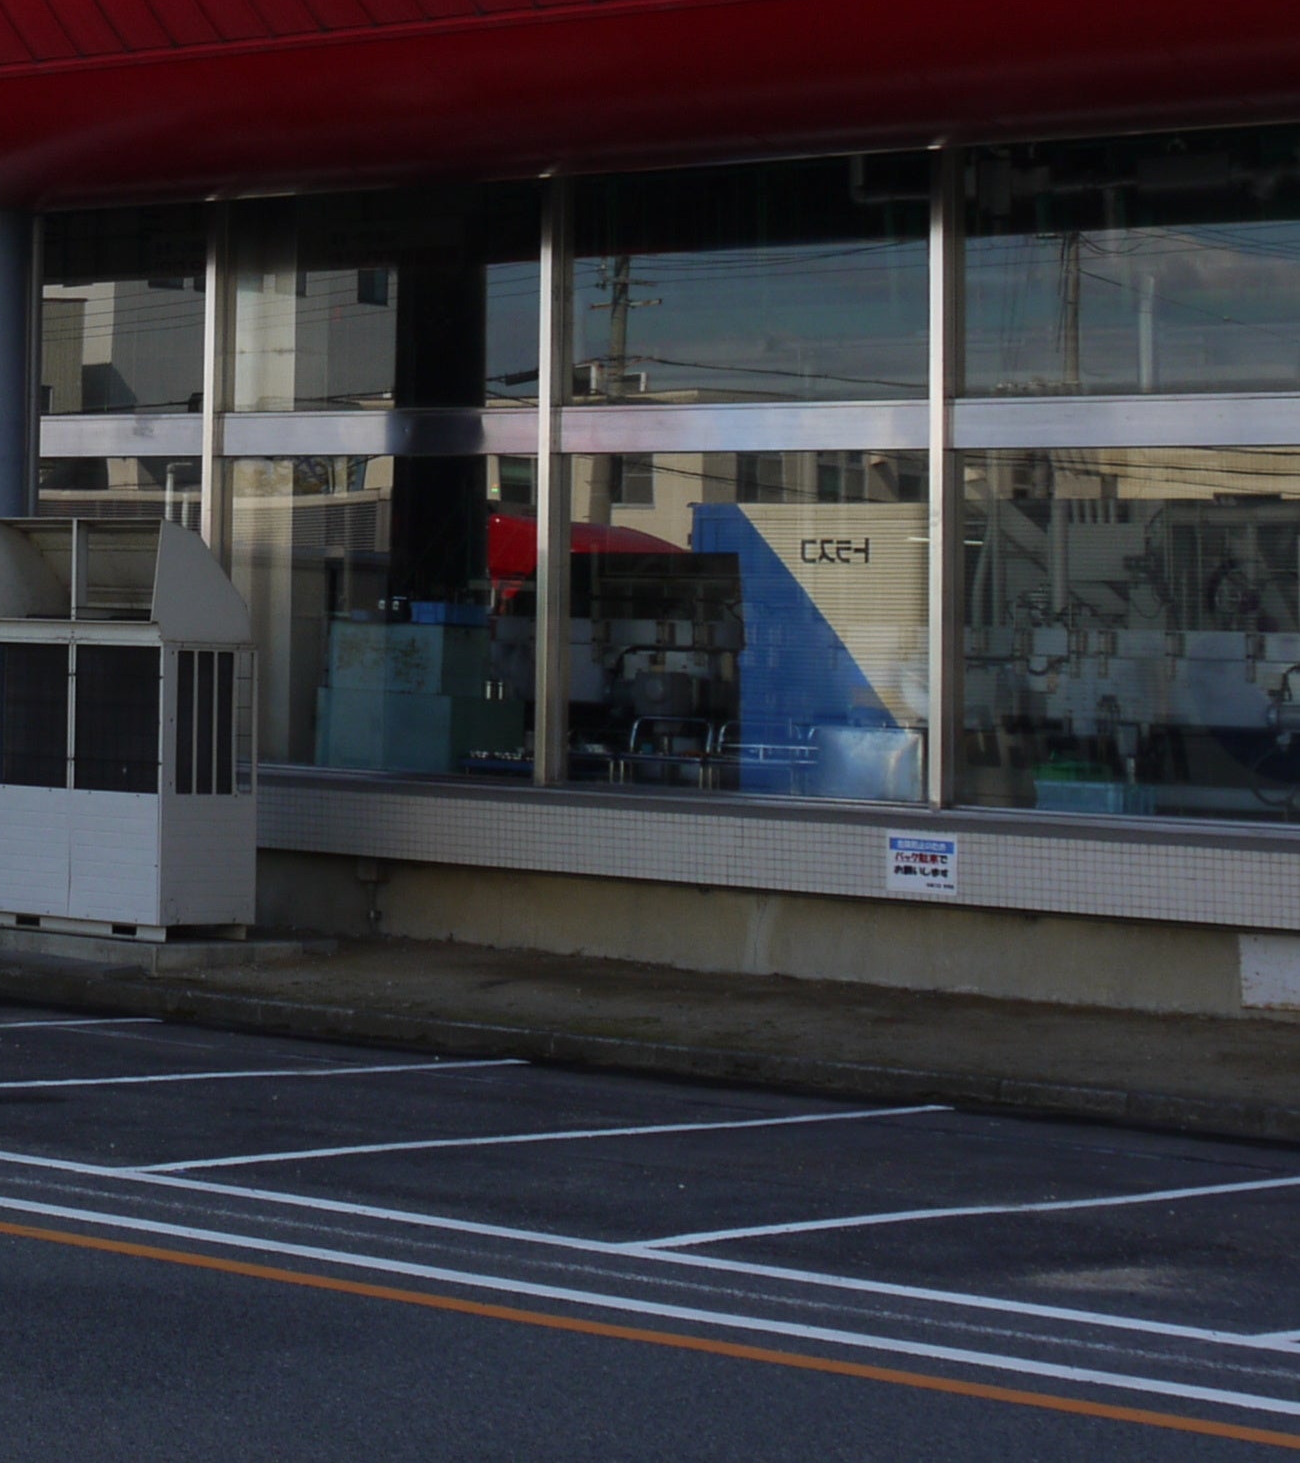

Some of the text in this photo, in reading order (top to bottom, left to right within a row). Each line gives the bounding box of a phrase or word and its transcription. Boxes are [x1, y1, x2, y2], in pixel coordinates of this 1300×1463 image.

[894, 864, 949, 879] お願いします
